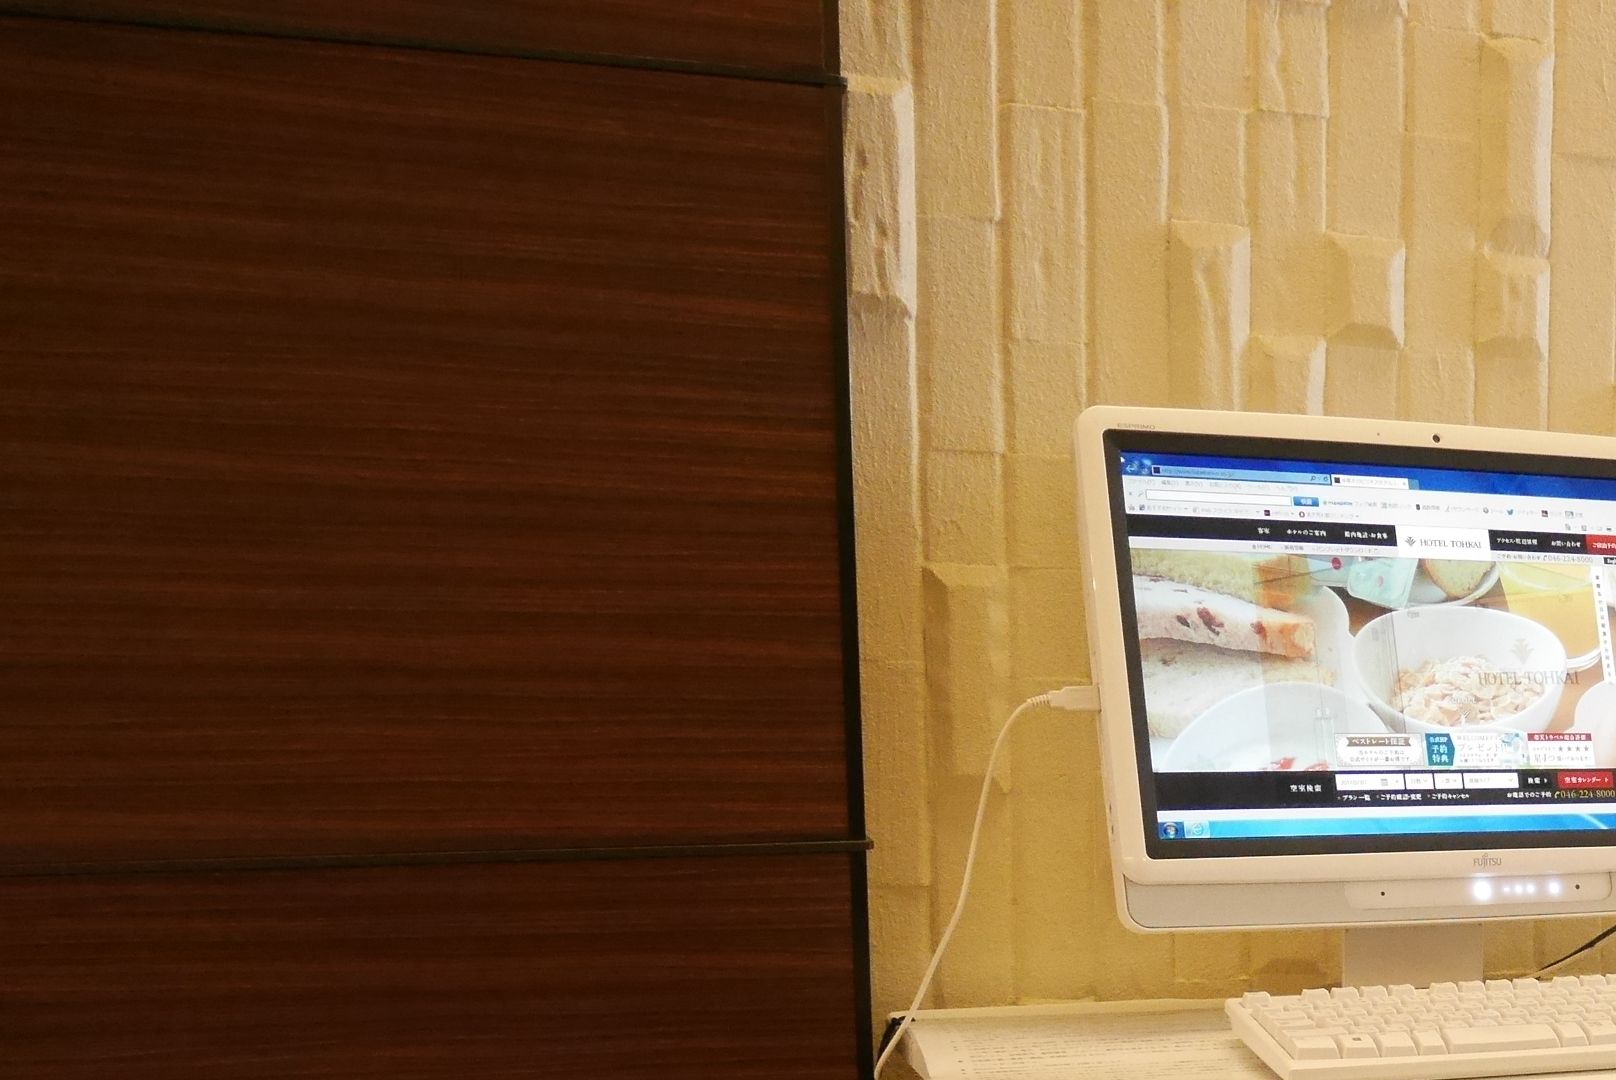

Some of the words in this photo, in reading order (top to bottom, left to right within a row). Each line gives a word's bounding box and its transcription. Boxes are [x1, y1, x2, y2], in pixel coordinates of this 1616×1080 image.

[1421, 539, 1448, 547] HOTEL
[1450, 540, 1482, 549] TOHKAI
[1478, 671, 1522, 686] HOTEL
[1523, 671, 1579, 685] TOHKAI
[1432, 744, 1448, 754] 予約
[1432, 754, 1449, 763] 特典
[1290, 784, 1322, 793] 空室検索
[1560, 789, 1616, 798] 046-224-8000
[1473, 857, 1502, 867] FUJITSU
